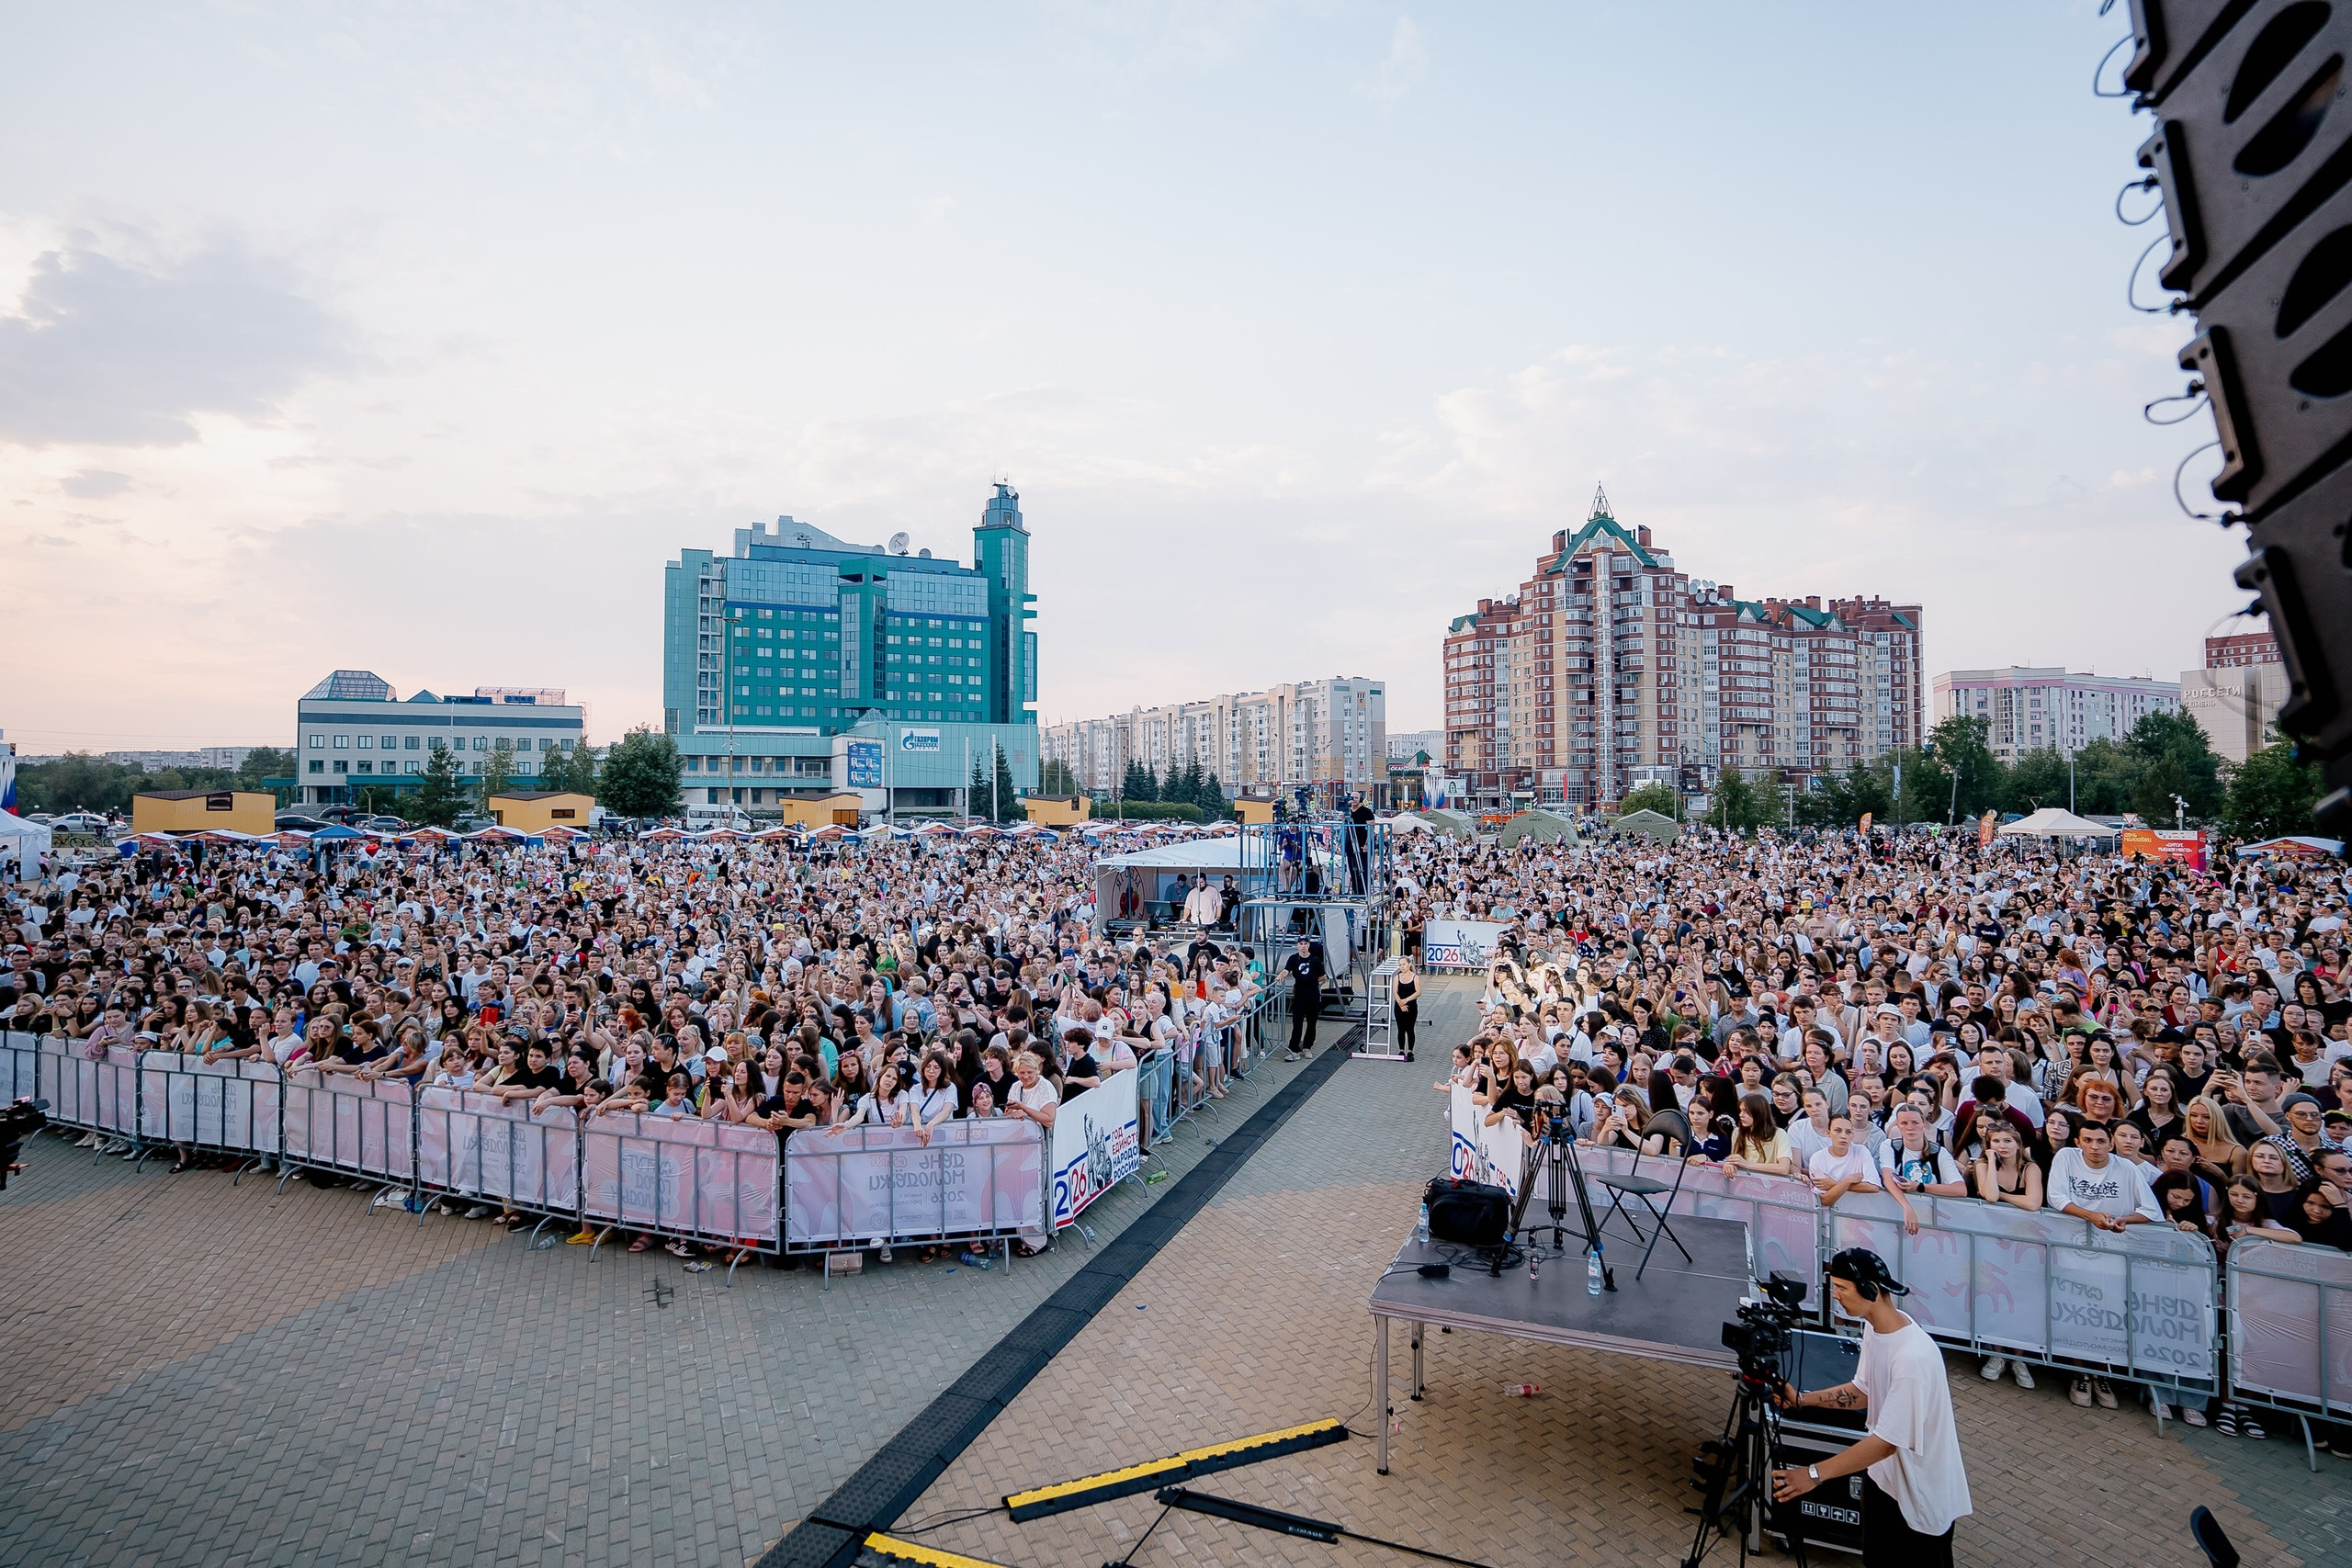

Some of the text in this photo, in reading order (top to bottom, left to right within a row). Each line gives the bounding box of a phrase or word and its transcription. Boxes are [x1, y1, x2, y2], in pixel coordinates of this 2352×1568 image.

[2184, 685, 2242, 699] РОССЕТИ
[1427, 947, 1459, 963] 2026
[1111, 1126, 1124, 1143] ГОД
[1112, 1132, 1139, 1156] ЕДИНСТВ
[1112, 1145, 1140, 1169] НАРОДО
[1113, 1156, 1140, 1182] РОССИИ
